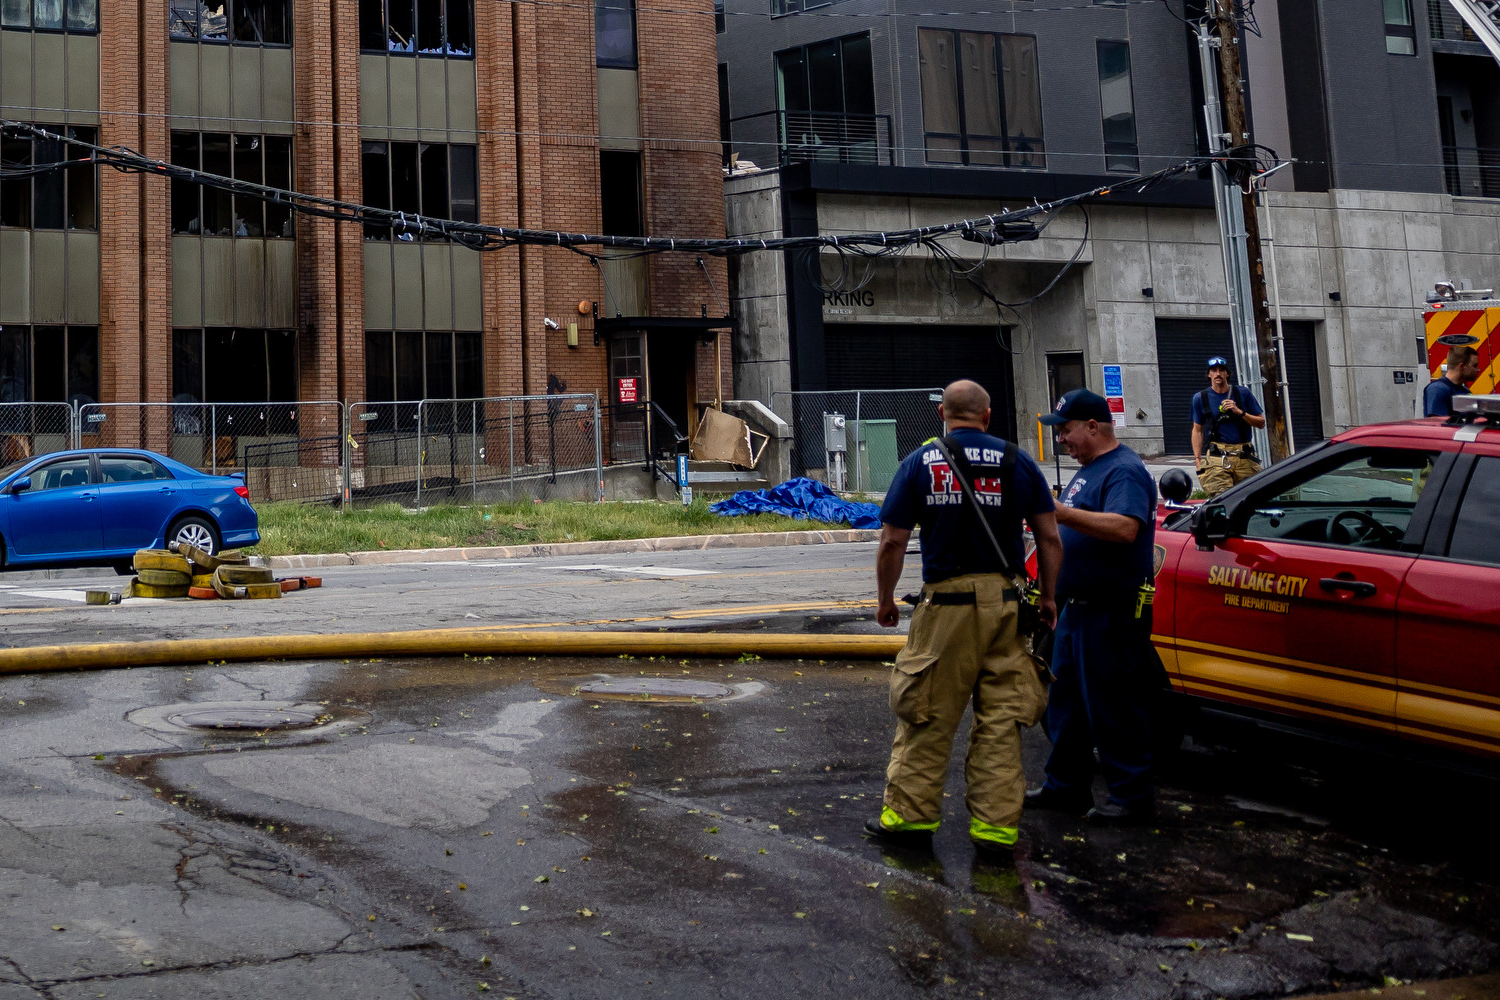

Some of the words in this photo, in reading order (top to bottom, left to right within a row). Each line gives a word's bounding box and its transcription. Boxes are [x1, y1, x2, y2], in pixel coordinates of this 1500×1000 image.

[822, 290, 875, 307] RKING
[923, 449, 945, 465] SAL
[983, 449, 1004, 464] CIT
[1208, 565, 1240, 587] SALT
[1240, 569, 1275, 593] LAKE
[1276, 575, 1308, 597] CITY
[1224, 593, 1239, 606] FIRE
[1241, 596, 1290, 614] DEPARTMENT
